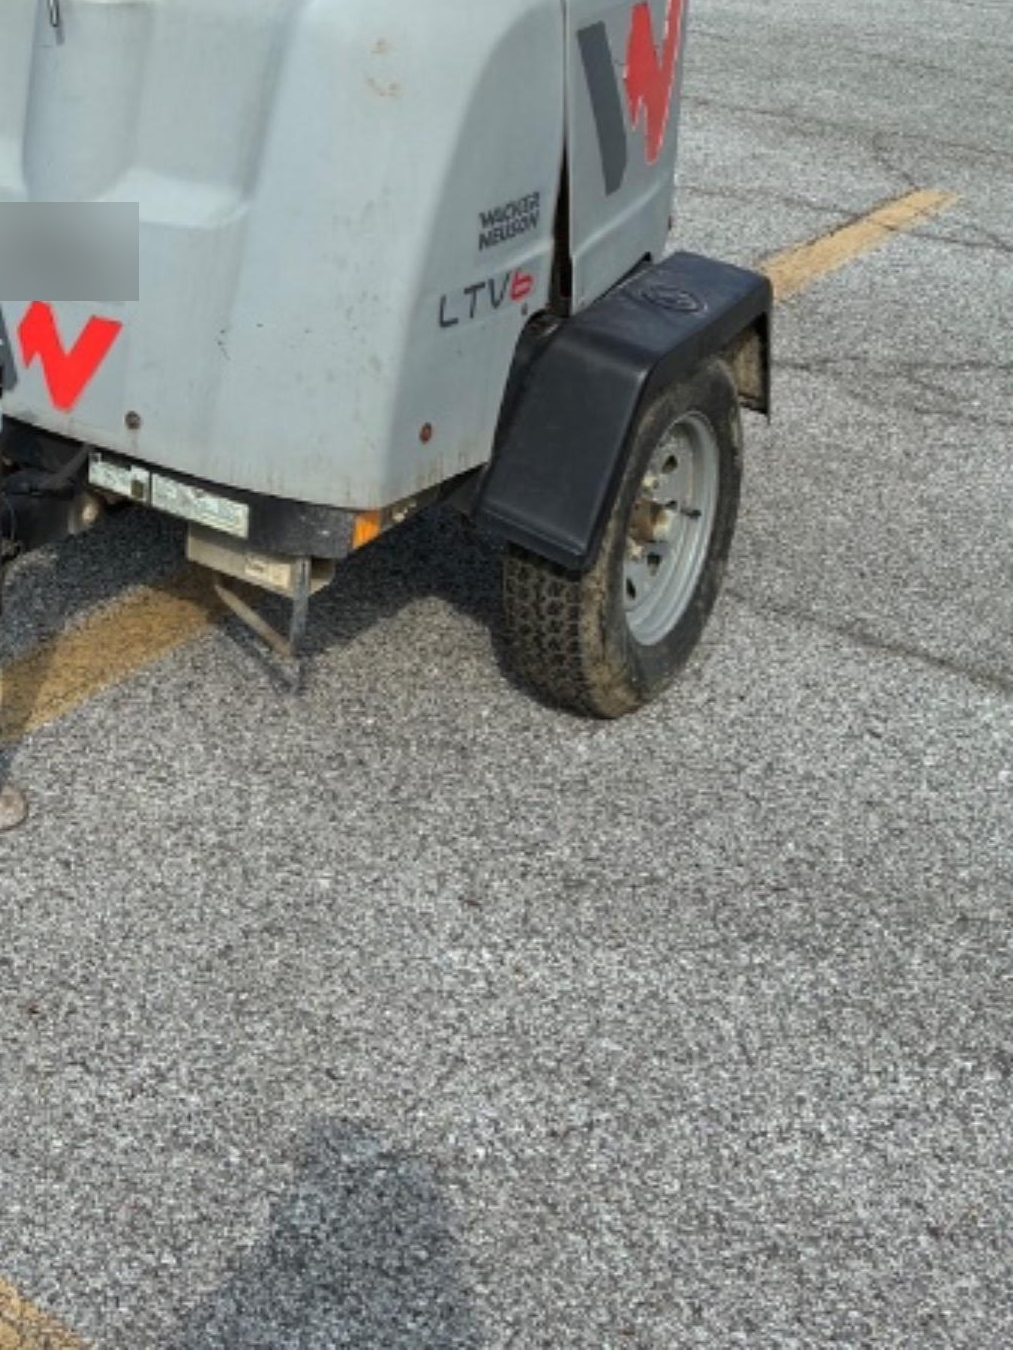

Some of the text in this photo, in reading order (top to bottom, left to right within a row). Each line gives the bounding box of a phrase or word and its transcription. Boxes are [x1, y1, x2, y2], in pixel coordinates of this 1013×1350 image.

[478, 191, 541, 228] WACKER
[478, 211, 540, 251] NEUSON
[438, 266, 535, 329] LTV6
